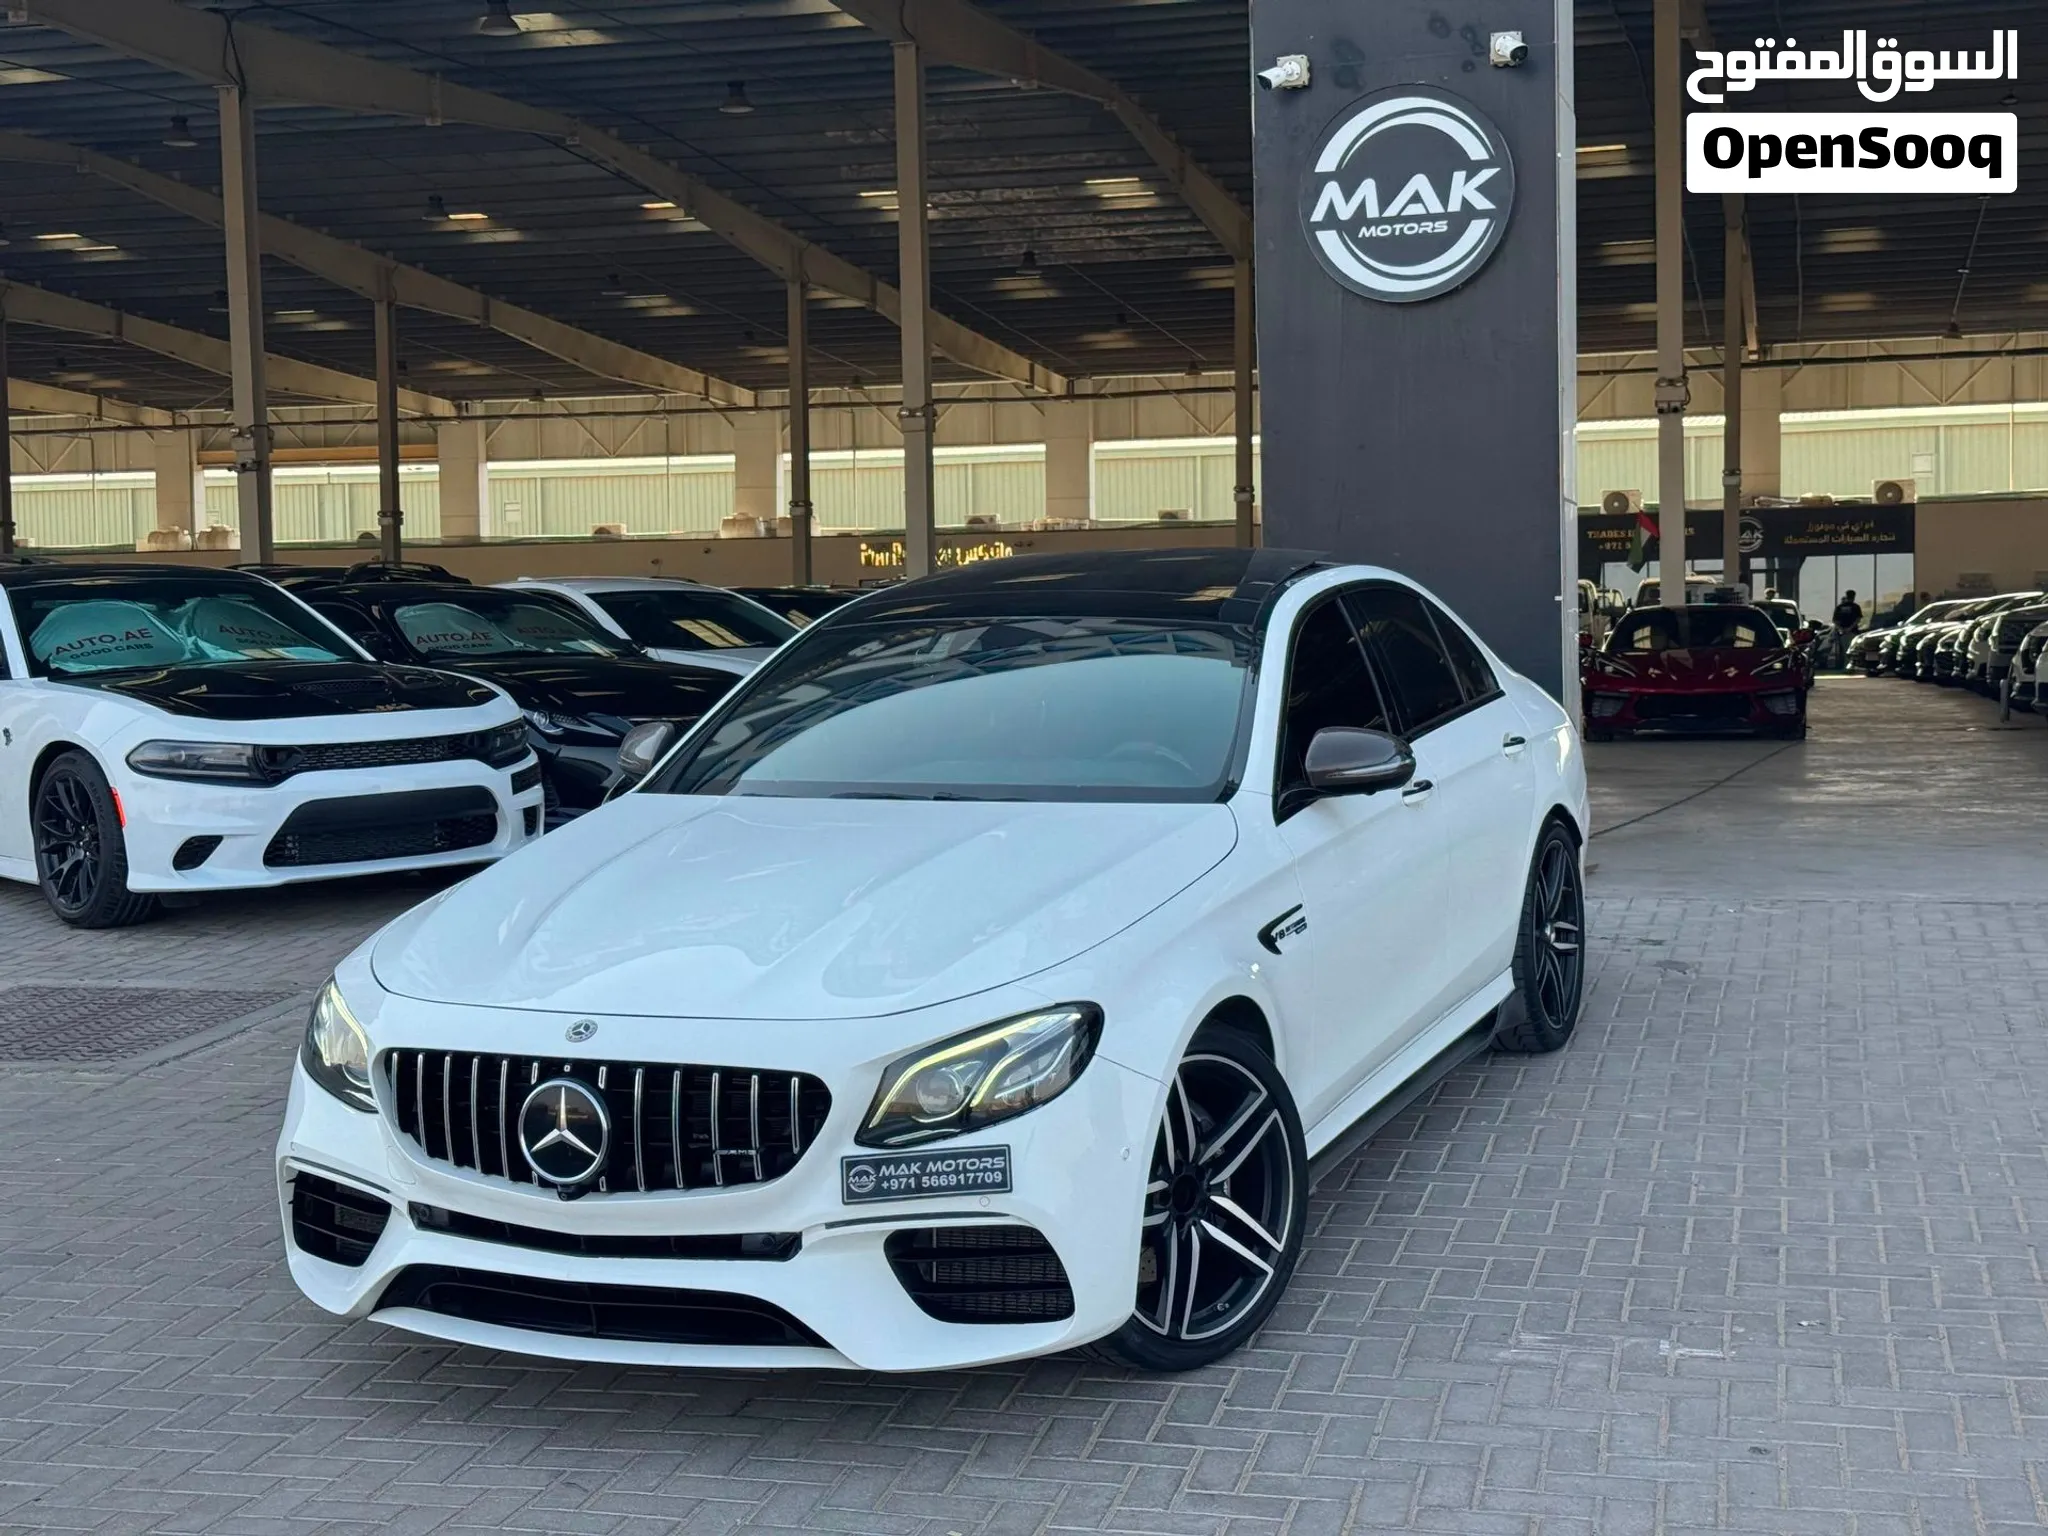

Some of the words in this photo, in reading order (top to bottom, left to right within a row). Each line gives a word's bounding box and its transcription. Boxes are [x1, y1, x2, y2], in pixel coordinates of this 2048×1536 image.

[1310, 167, 1501, 222] MAK
[1358, 220, 1449, 239] MOTORS
[56, 628, 154, 656] AUTO.AE
[416, 631, 492, 645] AUTO.AE
[69, 647, 112, 660] GOOD
[113, 642, 154, 652] CARS
[879, 1162, 921, 1177] MAK
[926, 1156, 1006, 1174] MOTORS
[847, 1174, 878, 1184] MAK
[881, 1177, 916, 1191] +971
[921, 1171, 1003, 1188] 566917709
